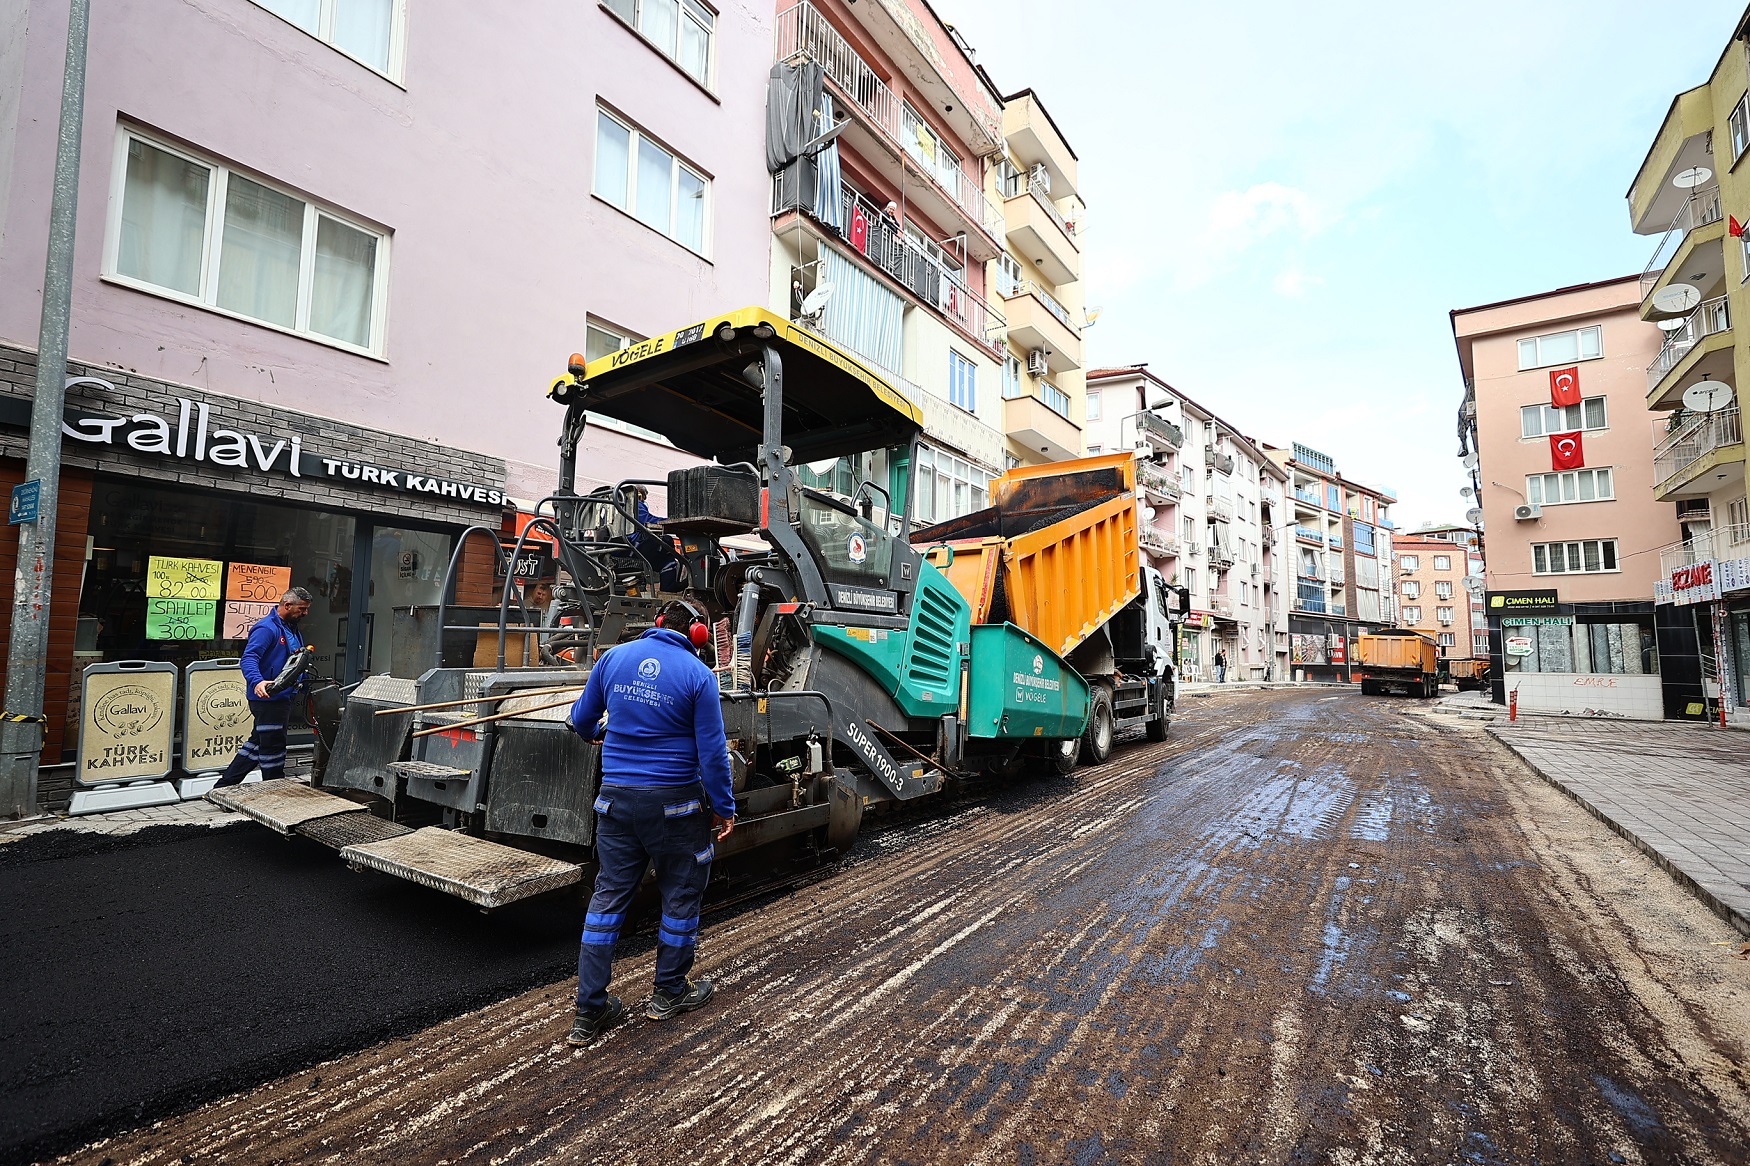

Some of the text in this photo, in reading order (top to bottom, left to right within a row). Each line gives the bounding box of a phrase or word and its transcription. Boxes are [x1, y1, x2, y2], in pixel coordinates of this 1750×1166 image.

[612, 338, 664, 368] VÖGELE
[62, 376, 508, 506] Gallavi TÜRK KAHVESİ
[1672, 563, 1712, 592] ECZANE
[241, 584, 277, 600] 500
[151, 601, 214, 616] SAHLEP
[1543, 617, 1572, 626] HALI
[158, 624, 198, 640] 300
[1573, 678, 1619, 688] EMRE
[210, 698, 242, 709] Gallavi
[1025, 689, 1047, 703] VÖGELE
[110, 703, 147, 716] Gallavi
[205, 735, 245, 748] TÜRK
[103, 744, 150, 758] TÜRK
[847, 722, 904, 791] SUPER 1900-3
[87, 750, 164, 770] KAHVESİ
